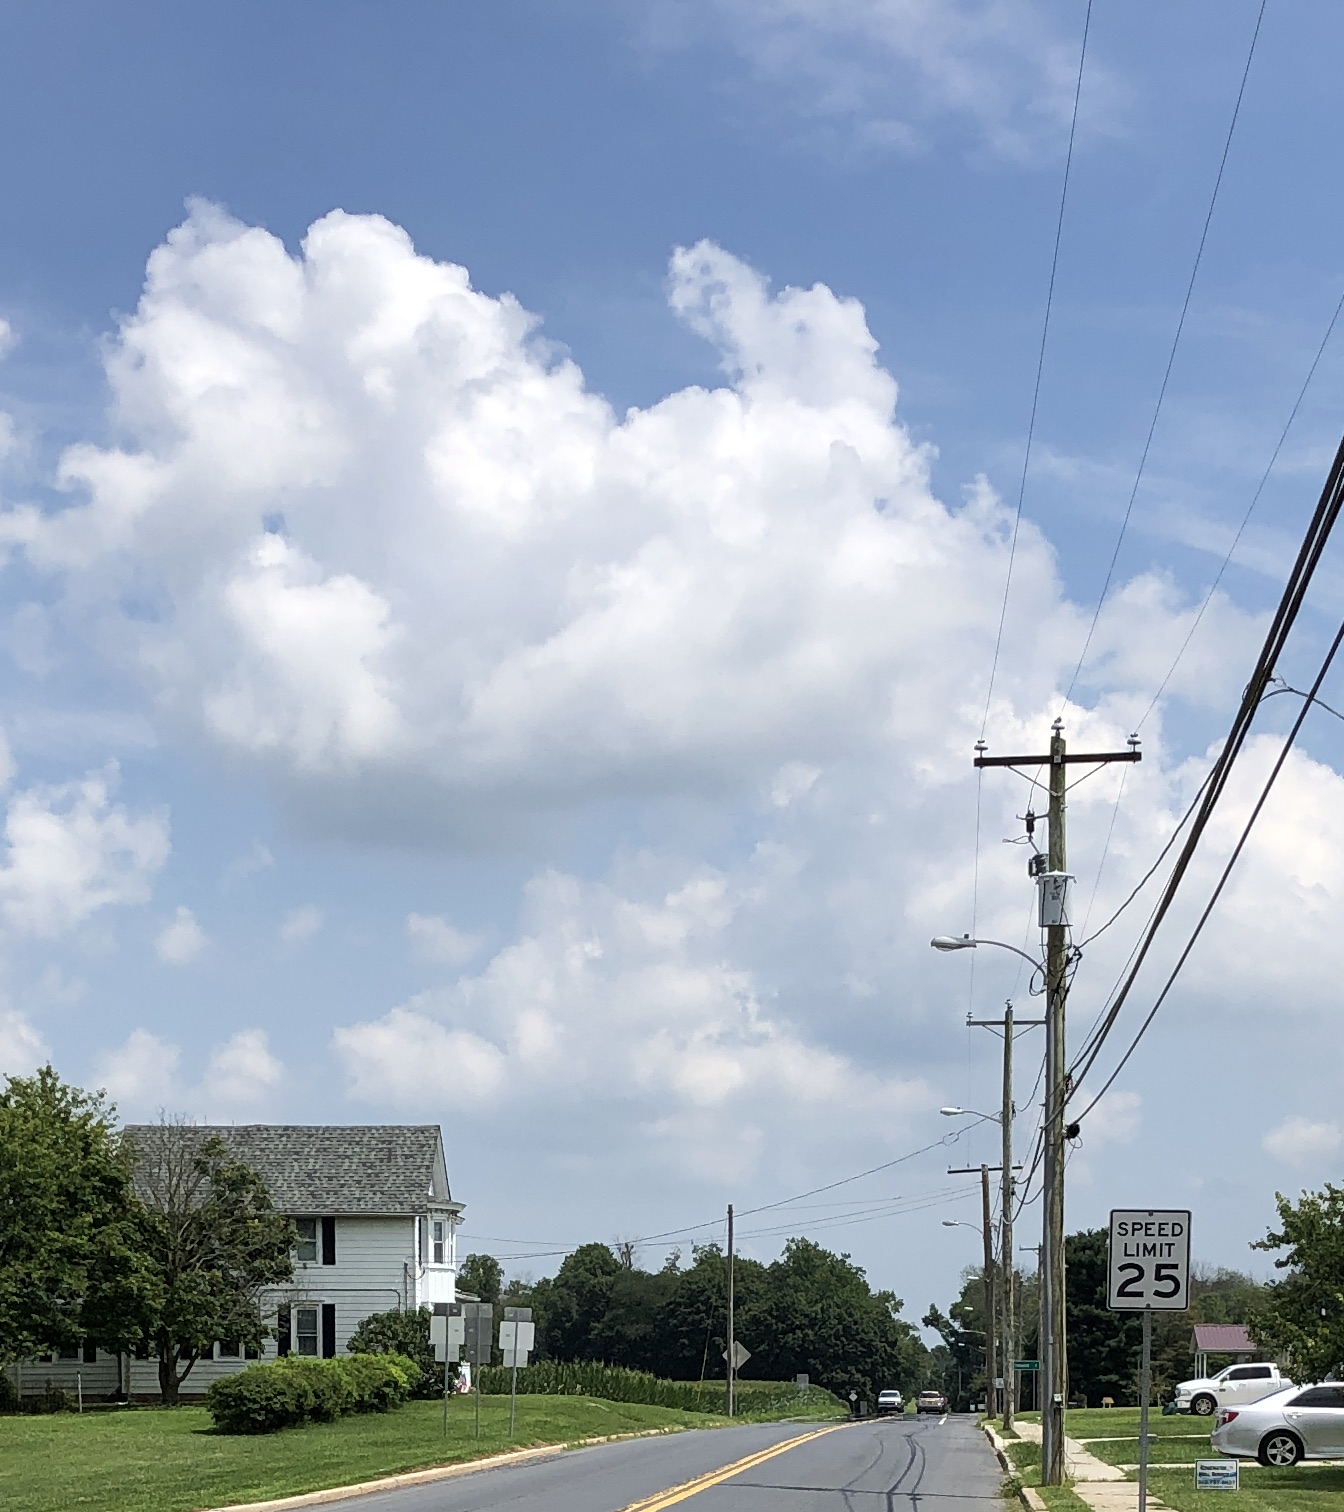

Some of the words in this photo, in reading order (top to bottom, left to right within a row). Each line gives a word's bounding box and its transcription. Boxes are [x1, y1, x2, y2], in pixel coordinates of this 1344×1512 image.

[1117, 1221, 1184, 1237] SPEED
[1123, 1242, 1176, 1258] LIMIT
[1116, 1262, 1181, 1299] 25
